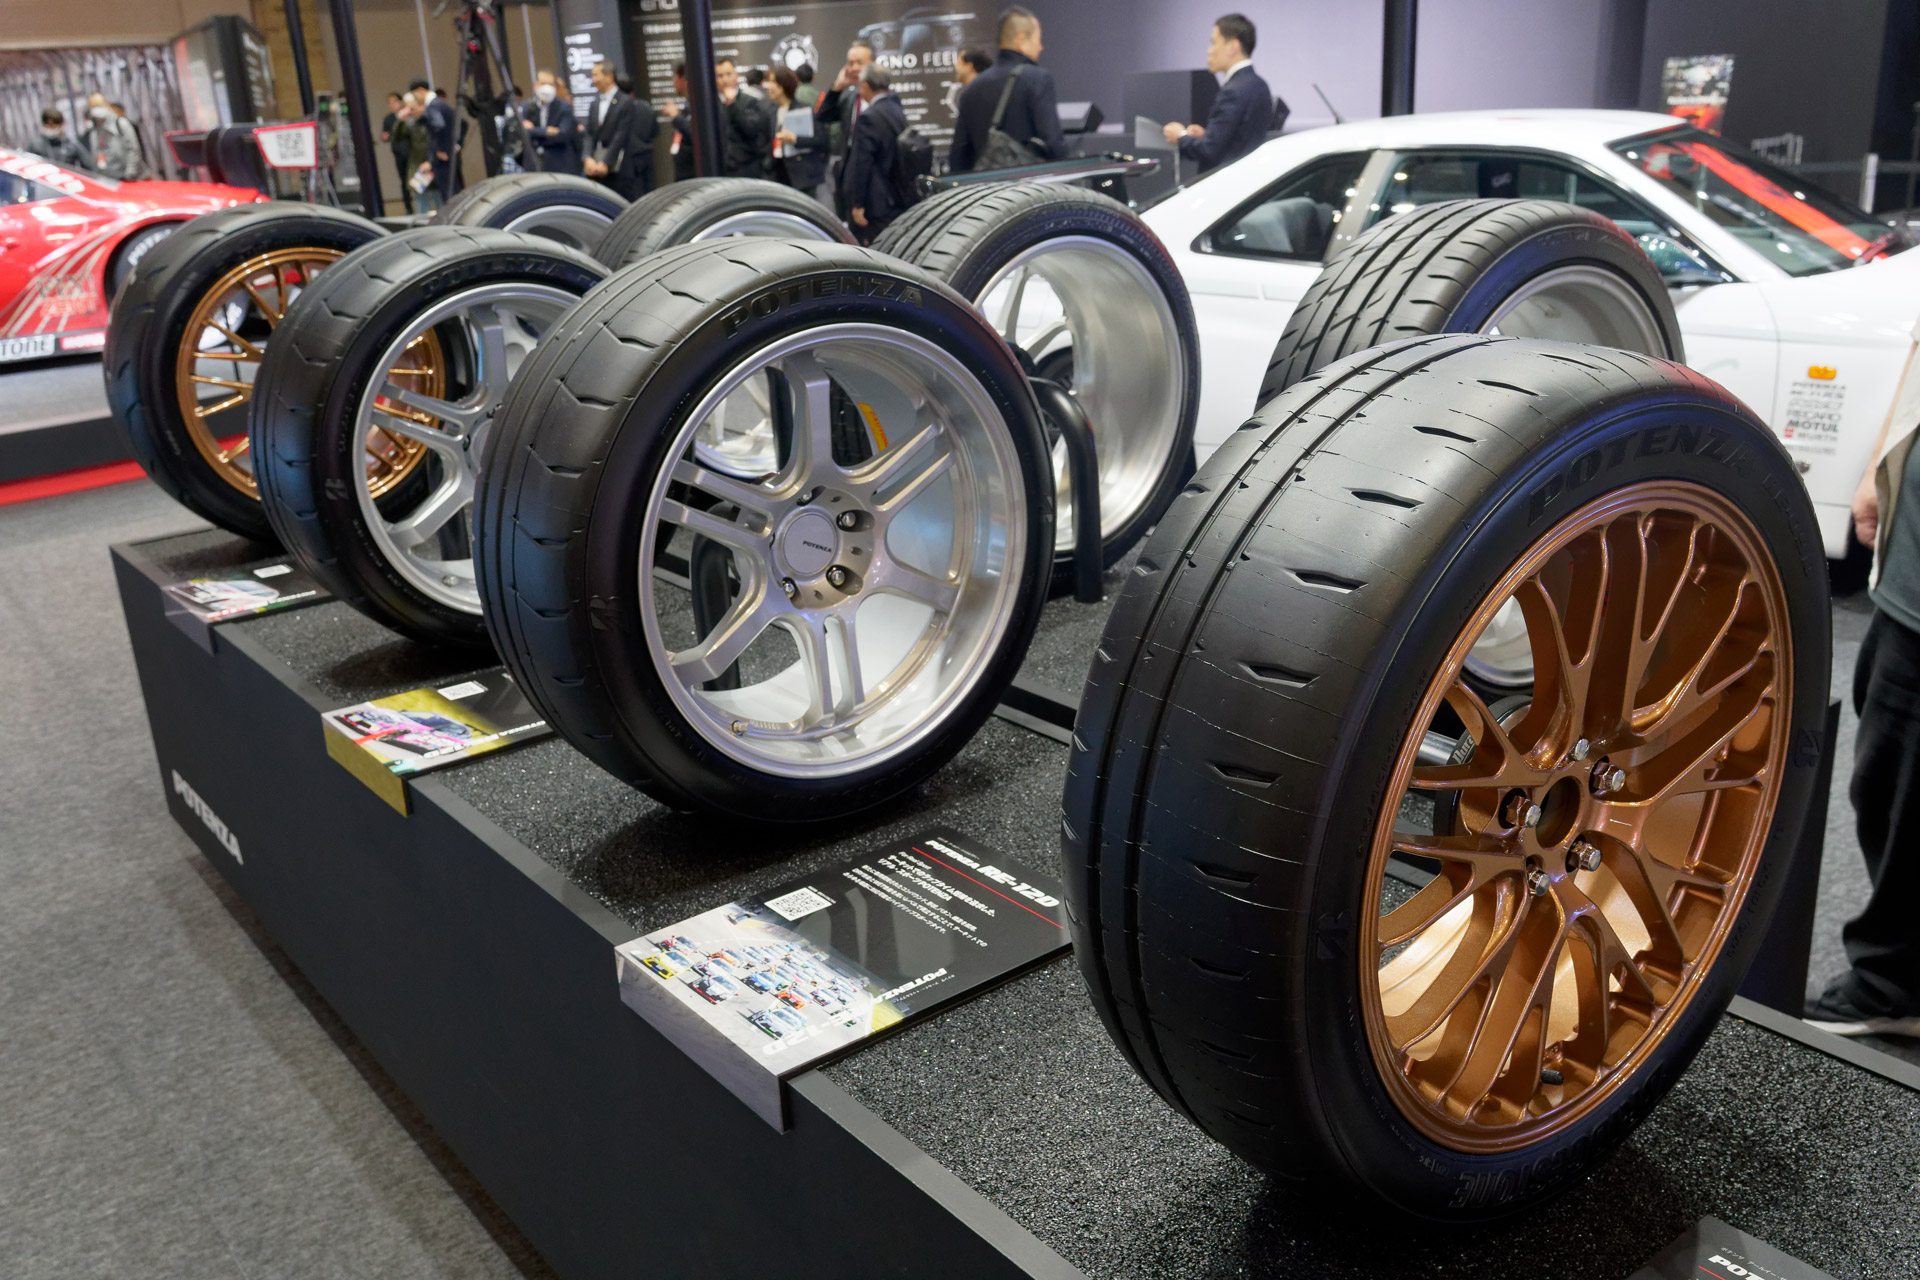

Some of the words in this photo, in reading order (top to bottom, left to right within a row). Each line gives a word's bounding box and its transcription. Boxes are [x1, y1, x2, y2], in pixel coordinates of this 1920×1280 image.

[720, 276, 924, 340] POTENZA
[1788, 419, 1839, 432] MOTUL
[1529, 424, 1752, 527] POTENZA
[802, 540, 832, 553] POTENZA
[172, 769, 244, 865] POTENZA
[925, 839, 980, 869] POTENZA
[977, 864, 1060, 908] RE-12D
[873, 967, 948, 1003] POTENZA
